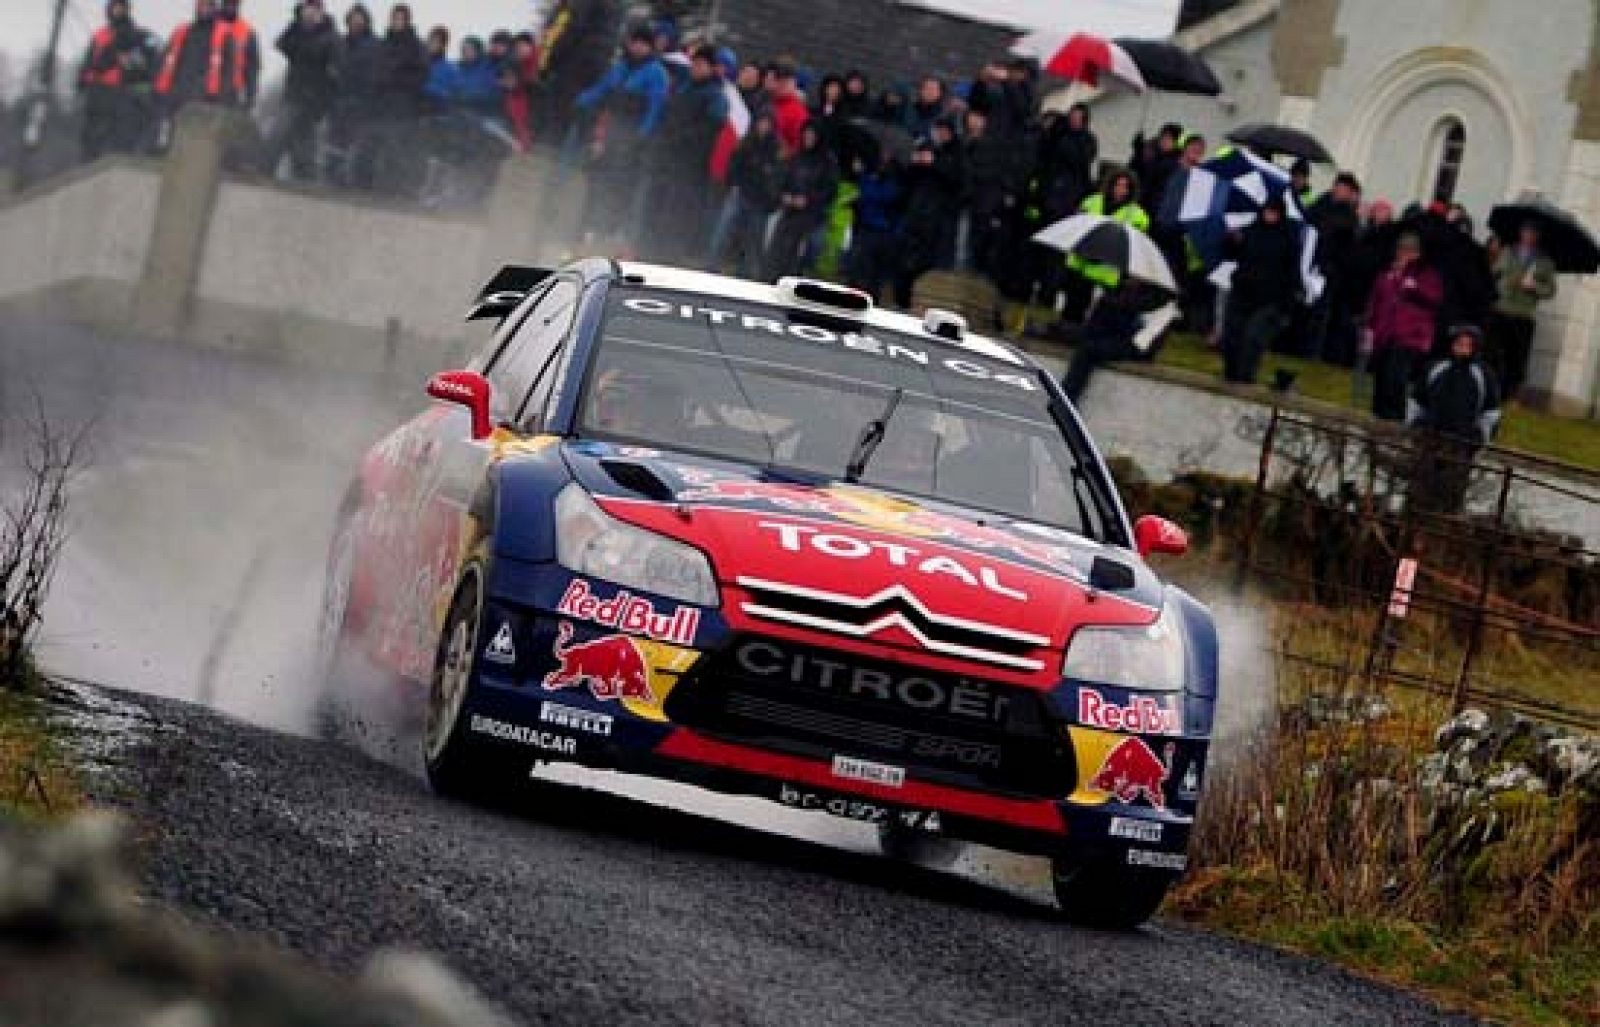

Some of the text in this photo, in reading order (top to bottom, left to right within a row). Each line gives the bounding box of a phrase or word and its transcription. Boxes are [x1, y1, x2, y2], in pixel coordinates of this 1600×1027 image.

[623, 298, 1036, 391] CITROËN C4
[758, 520, 1028, 601] TOTAL
[557, 578, 701, 647] Red Bull
[1078, 687, 1141, 732] Red
